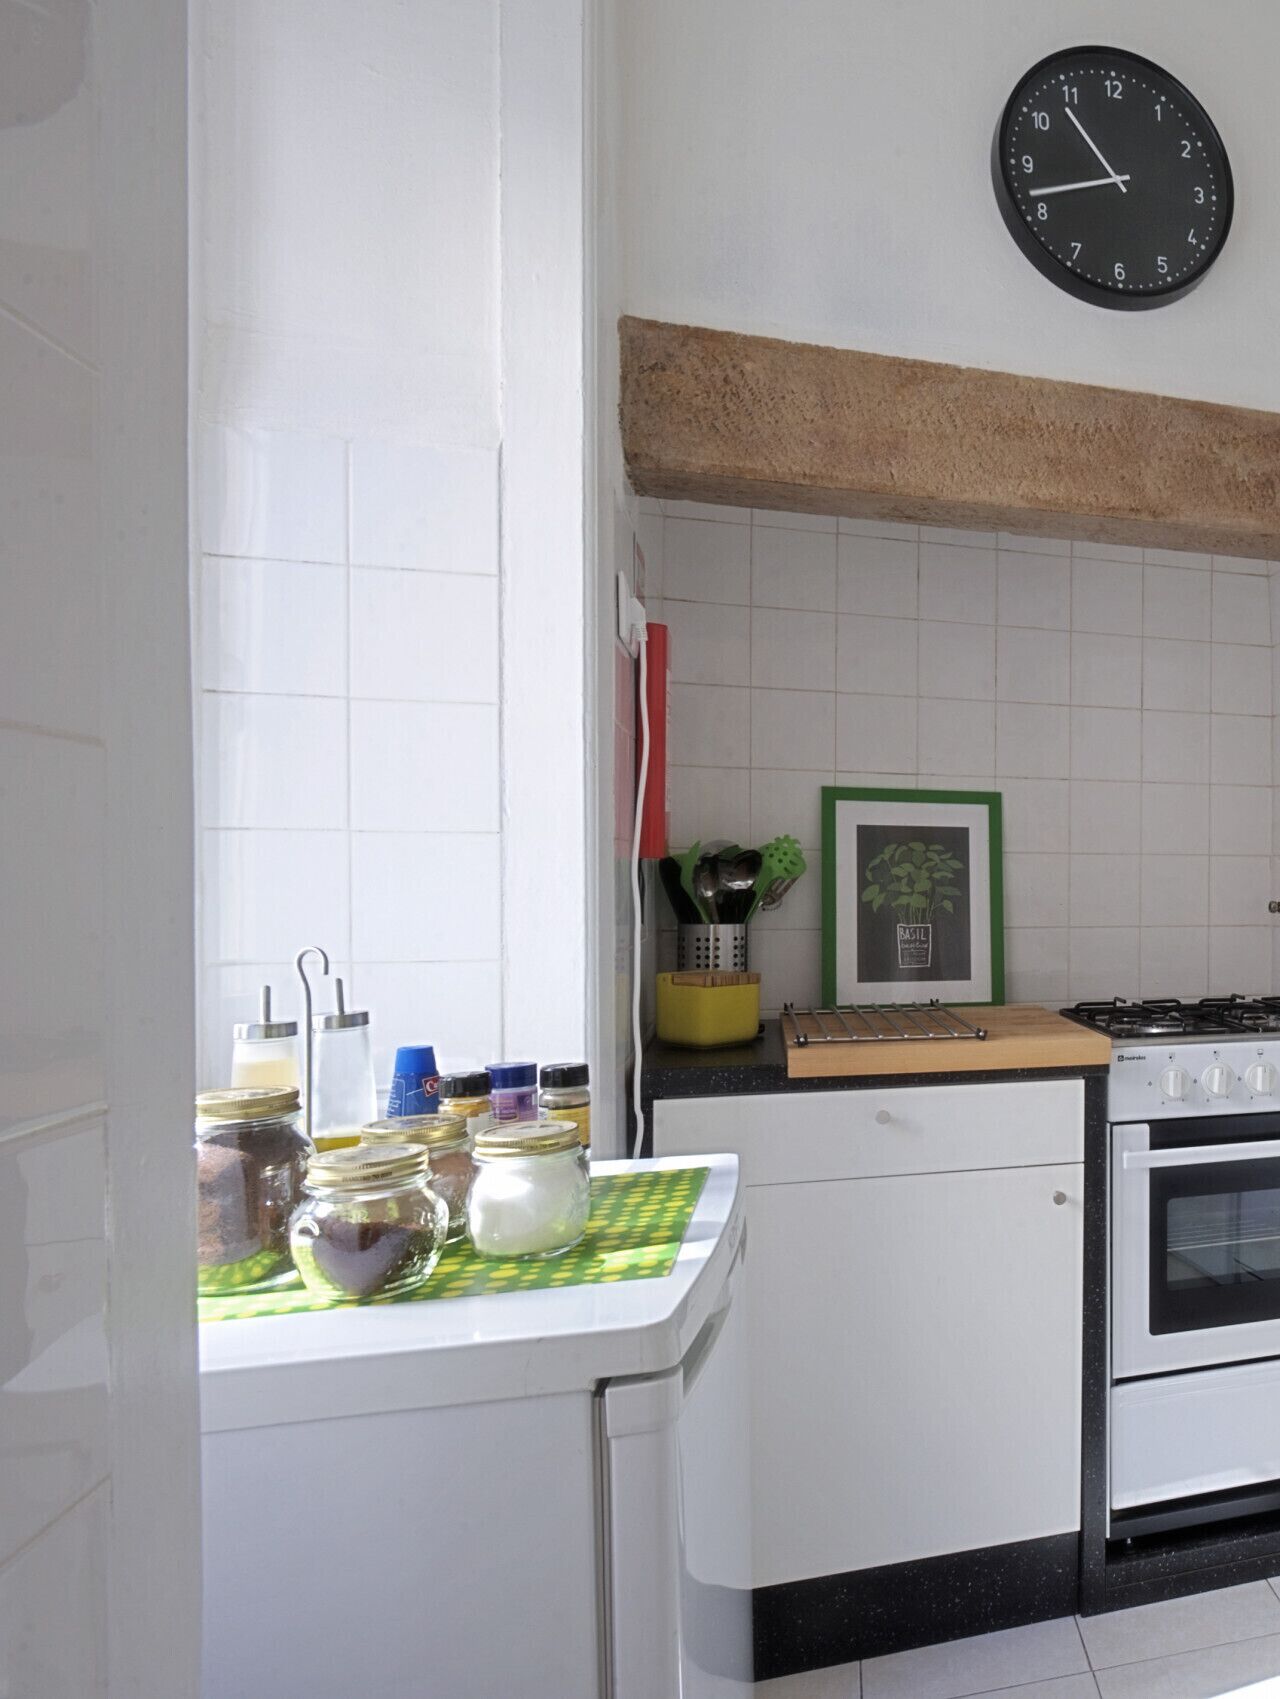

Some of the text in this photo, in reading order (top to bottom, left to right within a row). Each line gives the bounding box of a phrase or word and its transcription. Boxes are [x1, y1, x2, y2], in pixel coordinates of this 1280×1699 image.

[1062, 85, 1078, 105] 11
[1104, 80, 1123, 99] 12
[1031, 111, 1050, 131] 10
[1154, 104, 1162, 122] 1
[1180, 140, 1192, 159] 2
[1021, 155, 1034, 173] 9
[1193, 187, 1205, 204] 3
[1037, 202, 1048, 220] 8
[1187, 228, 1197, 245] 4
[1070, 242, 1082, 260] 7
[1114, 263, 1126, 281] 6
[1157, 256, 1168, 274] 5
[899, 927, 927, 940] BASIL
